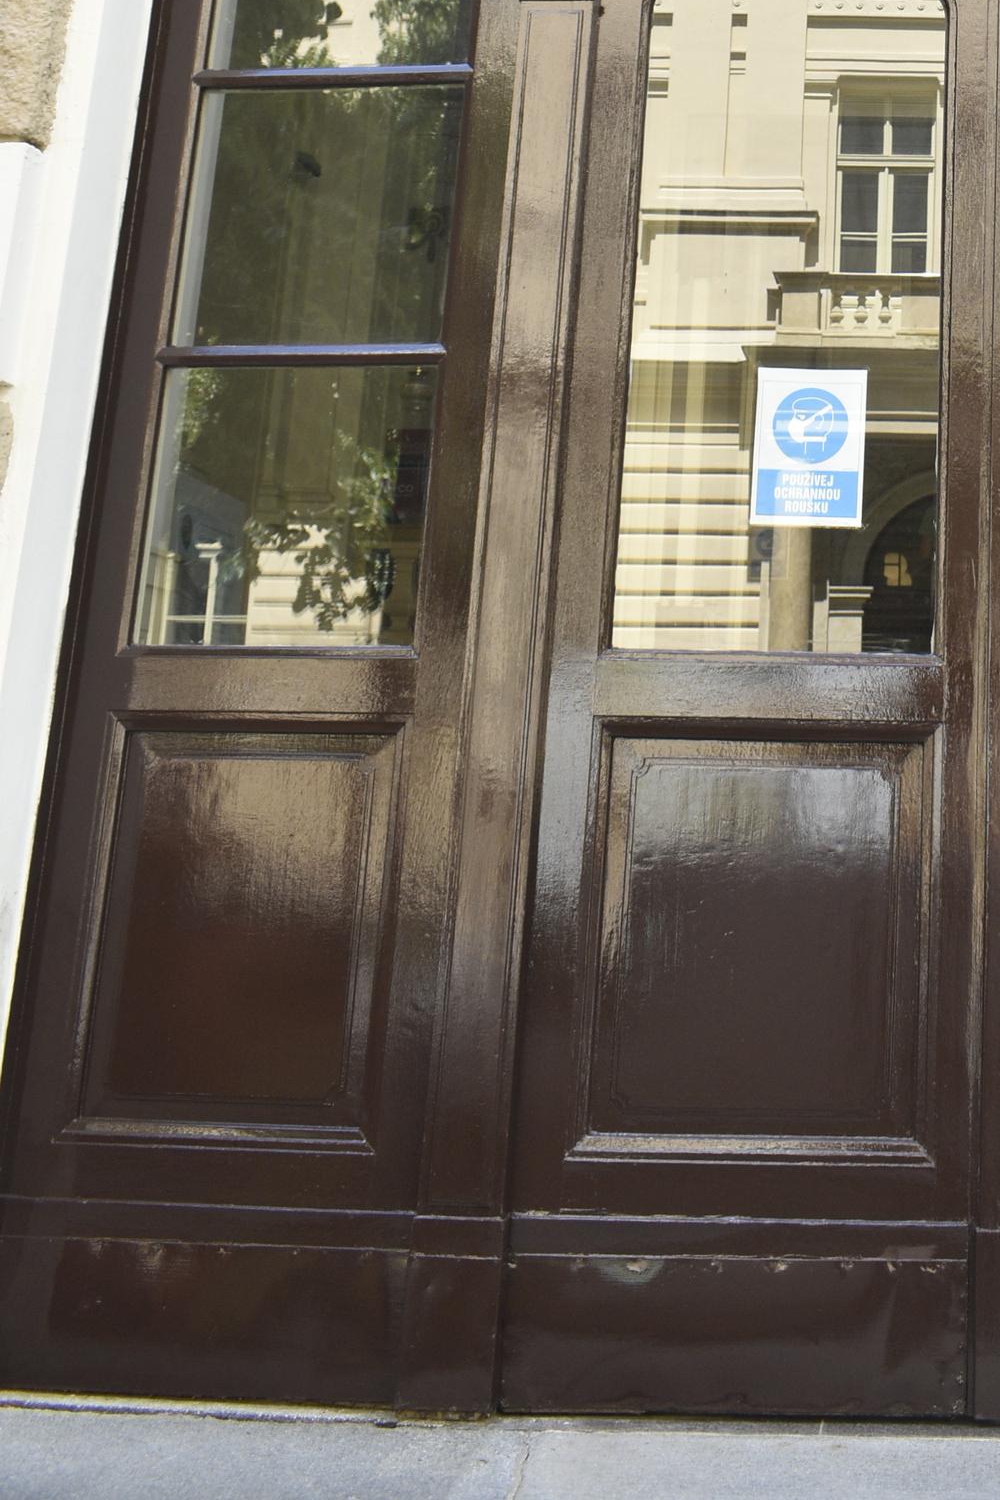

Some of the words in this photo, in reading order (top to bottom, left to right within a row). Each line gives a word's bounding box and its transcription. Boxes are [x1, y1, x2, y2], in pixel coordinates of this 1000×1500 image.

[783, 472, 833, 486] POUŽÍVEJ
[774, 487, 840, 500] OCHRANNOU
[785, 499, 828, 513] ROUŠKU
